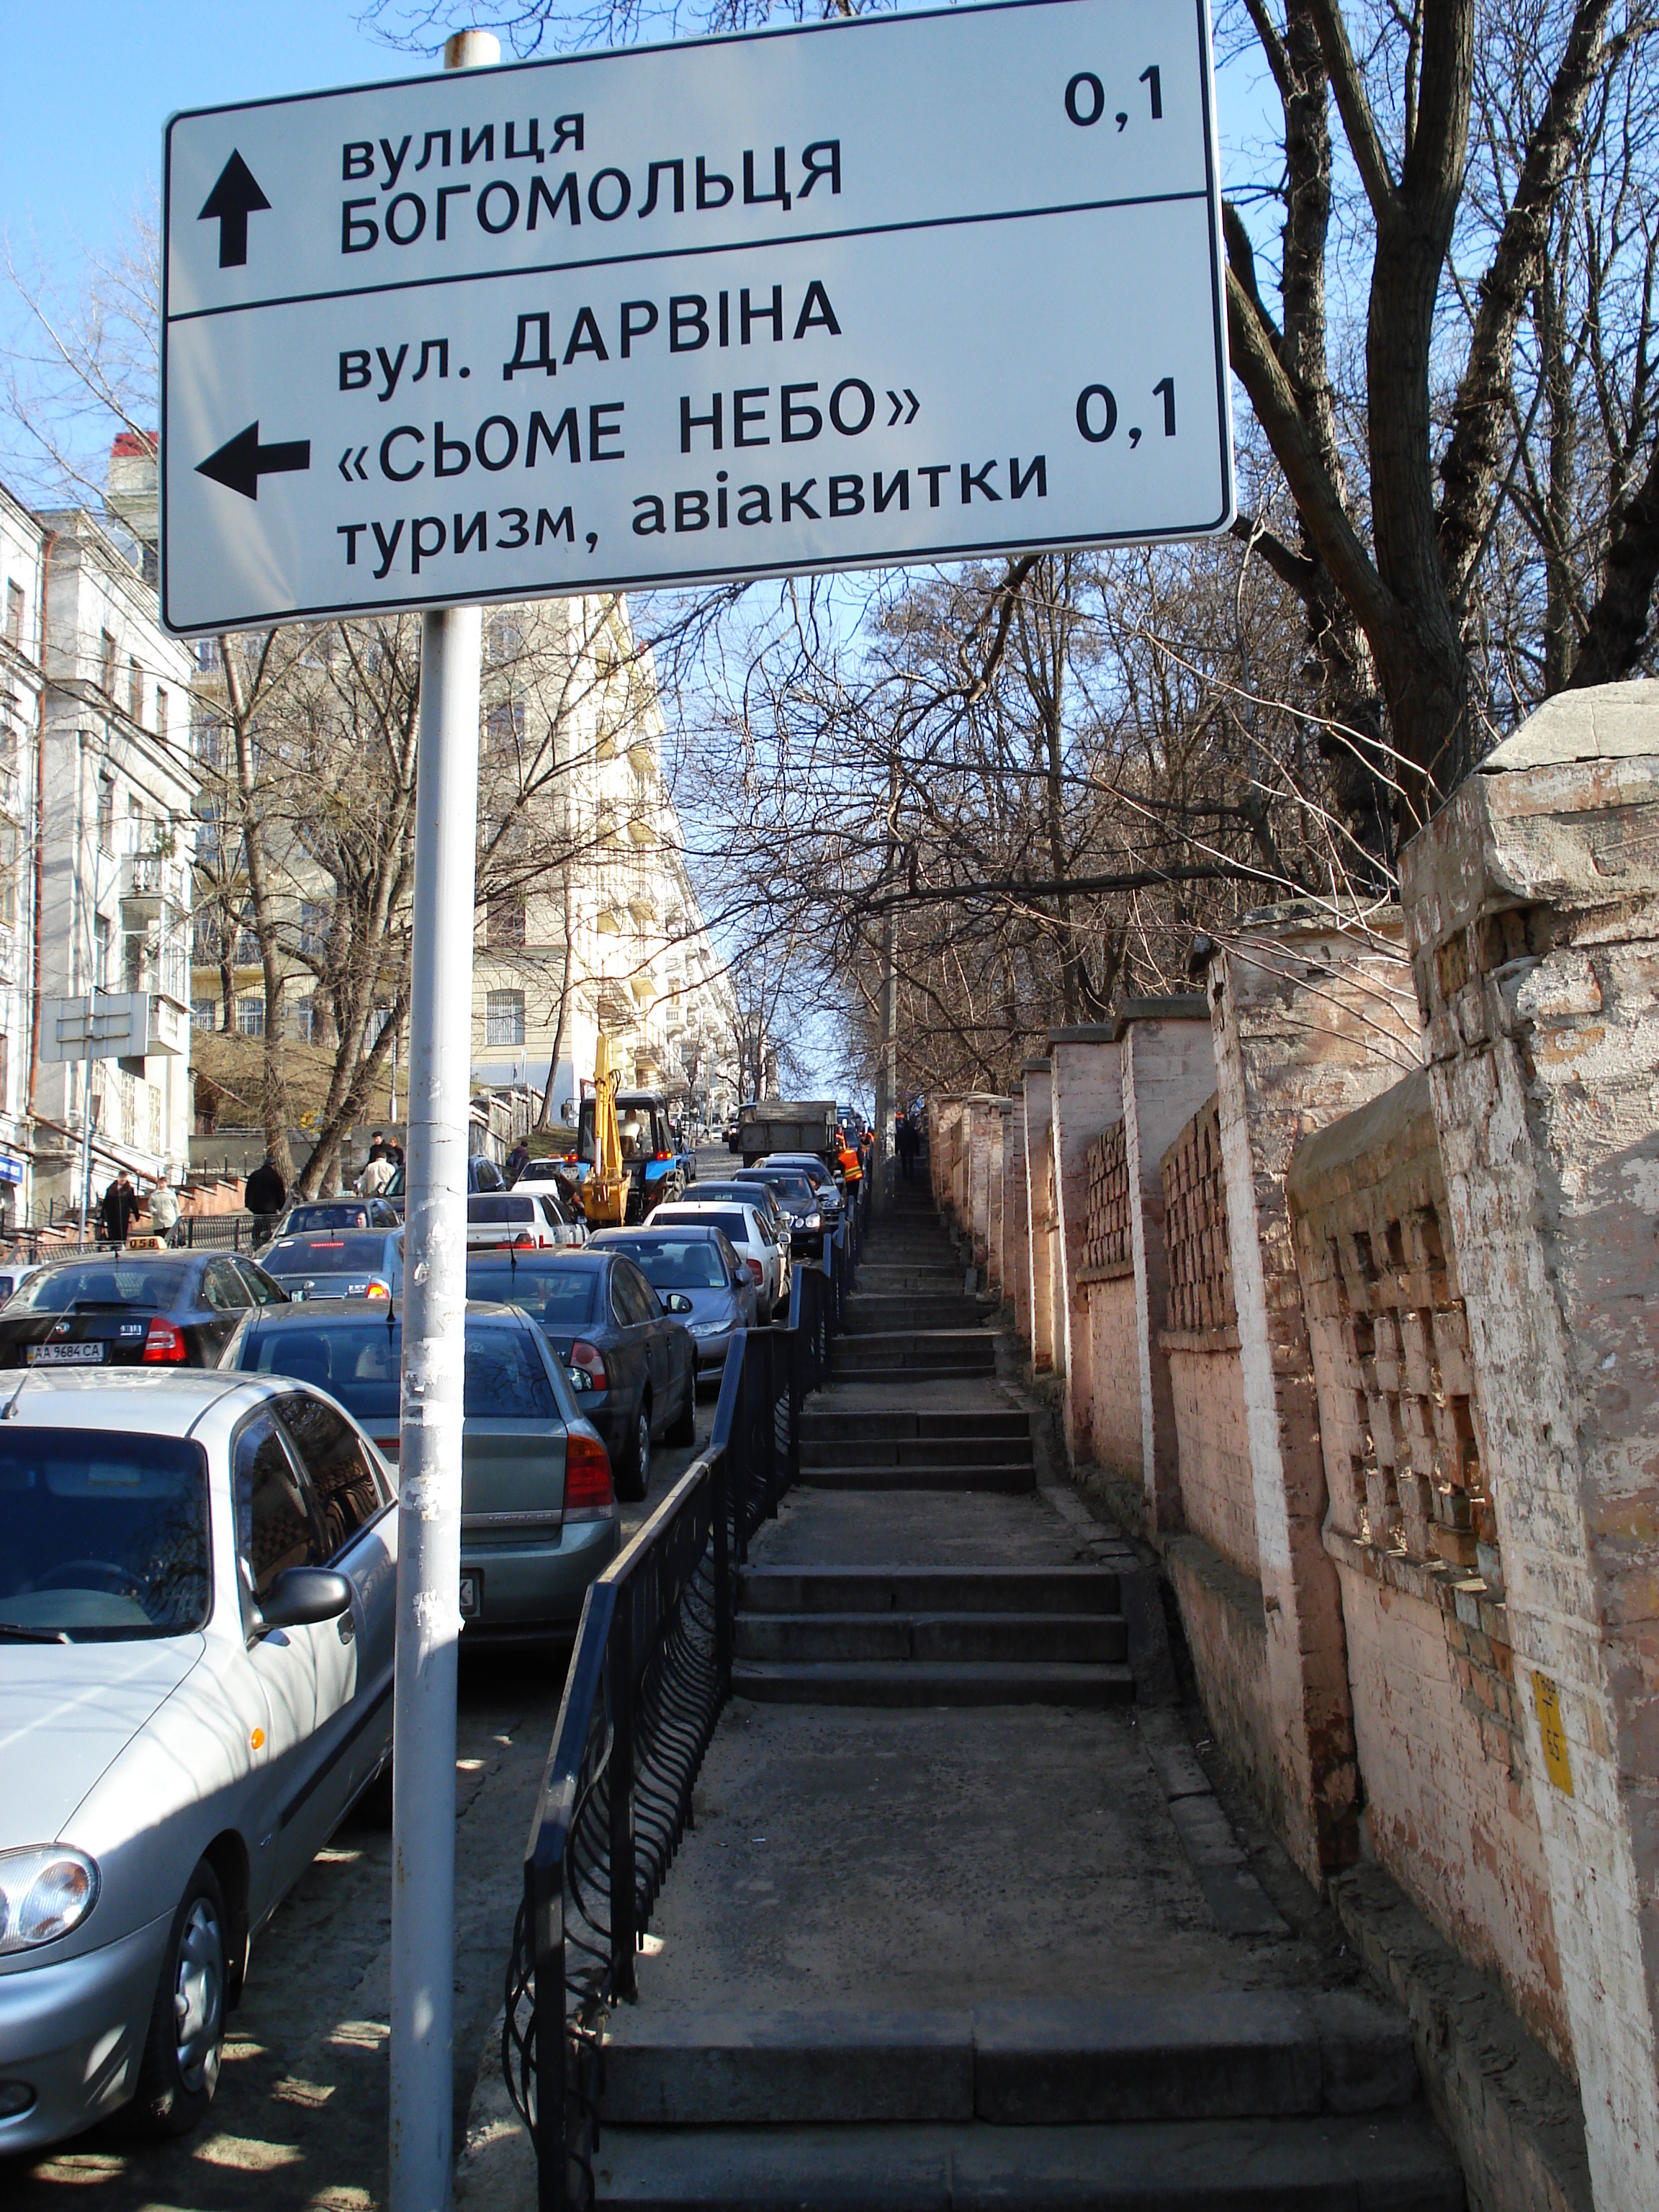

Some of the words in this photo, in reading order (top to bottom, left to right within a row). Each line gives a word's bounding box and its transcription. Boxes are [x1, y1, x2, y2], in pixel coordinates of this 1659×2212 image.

[1064, 65, 1163, 132] 0,1
[342, 112, 584, 192] вулиця
[341, 139, 841, 254] БОГОМОЛЬЦЯ
[339, 338, 471, 403] вул.
[503, 280, 842, 381] ДАРВІНА
[338, 401, 625, 482] «СЬОМЕ
[680, 378, 920, 454] НЕБО»
[1076, 377, 1176, 449] 0,1
[336, 505, 598, 580] туризм,
[632, 454, 1047, 536] авіаквитки
[130, 1238, 156, 1249] 058
[35, 1346, 50, 1359] AA
[54, 1345, 81, 1358] 9684
[83, 1344, 100, 1357] CA
